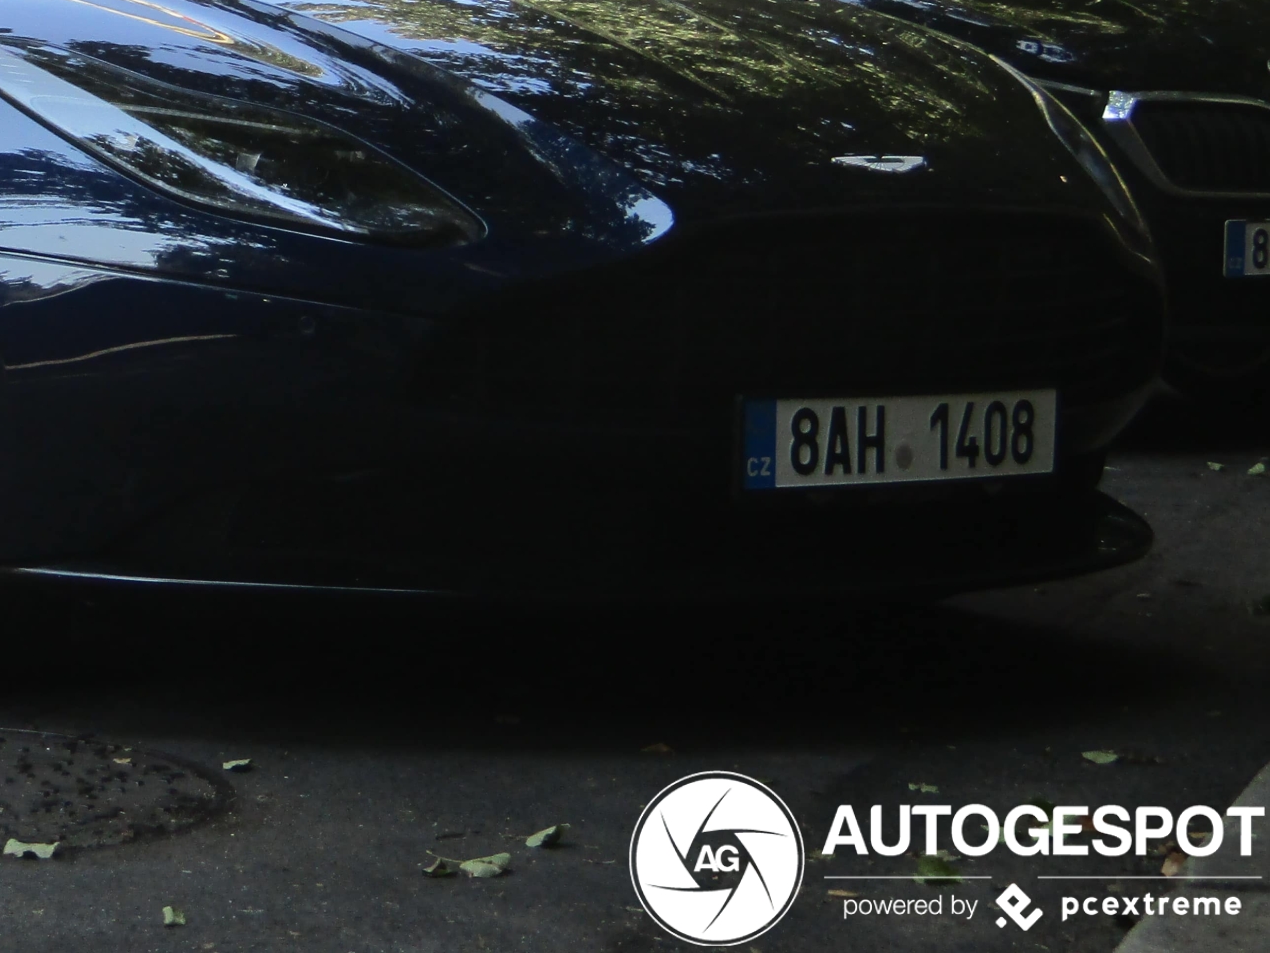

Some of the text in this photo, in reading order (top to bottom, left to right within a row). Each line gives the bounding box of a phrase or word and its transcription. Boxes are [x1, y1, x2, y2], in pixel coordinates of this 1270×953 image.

[790, 399, 1034, 476] 8AH 1408
[747, 456, 771, 477] CZ
